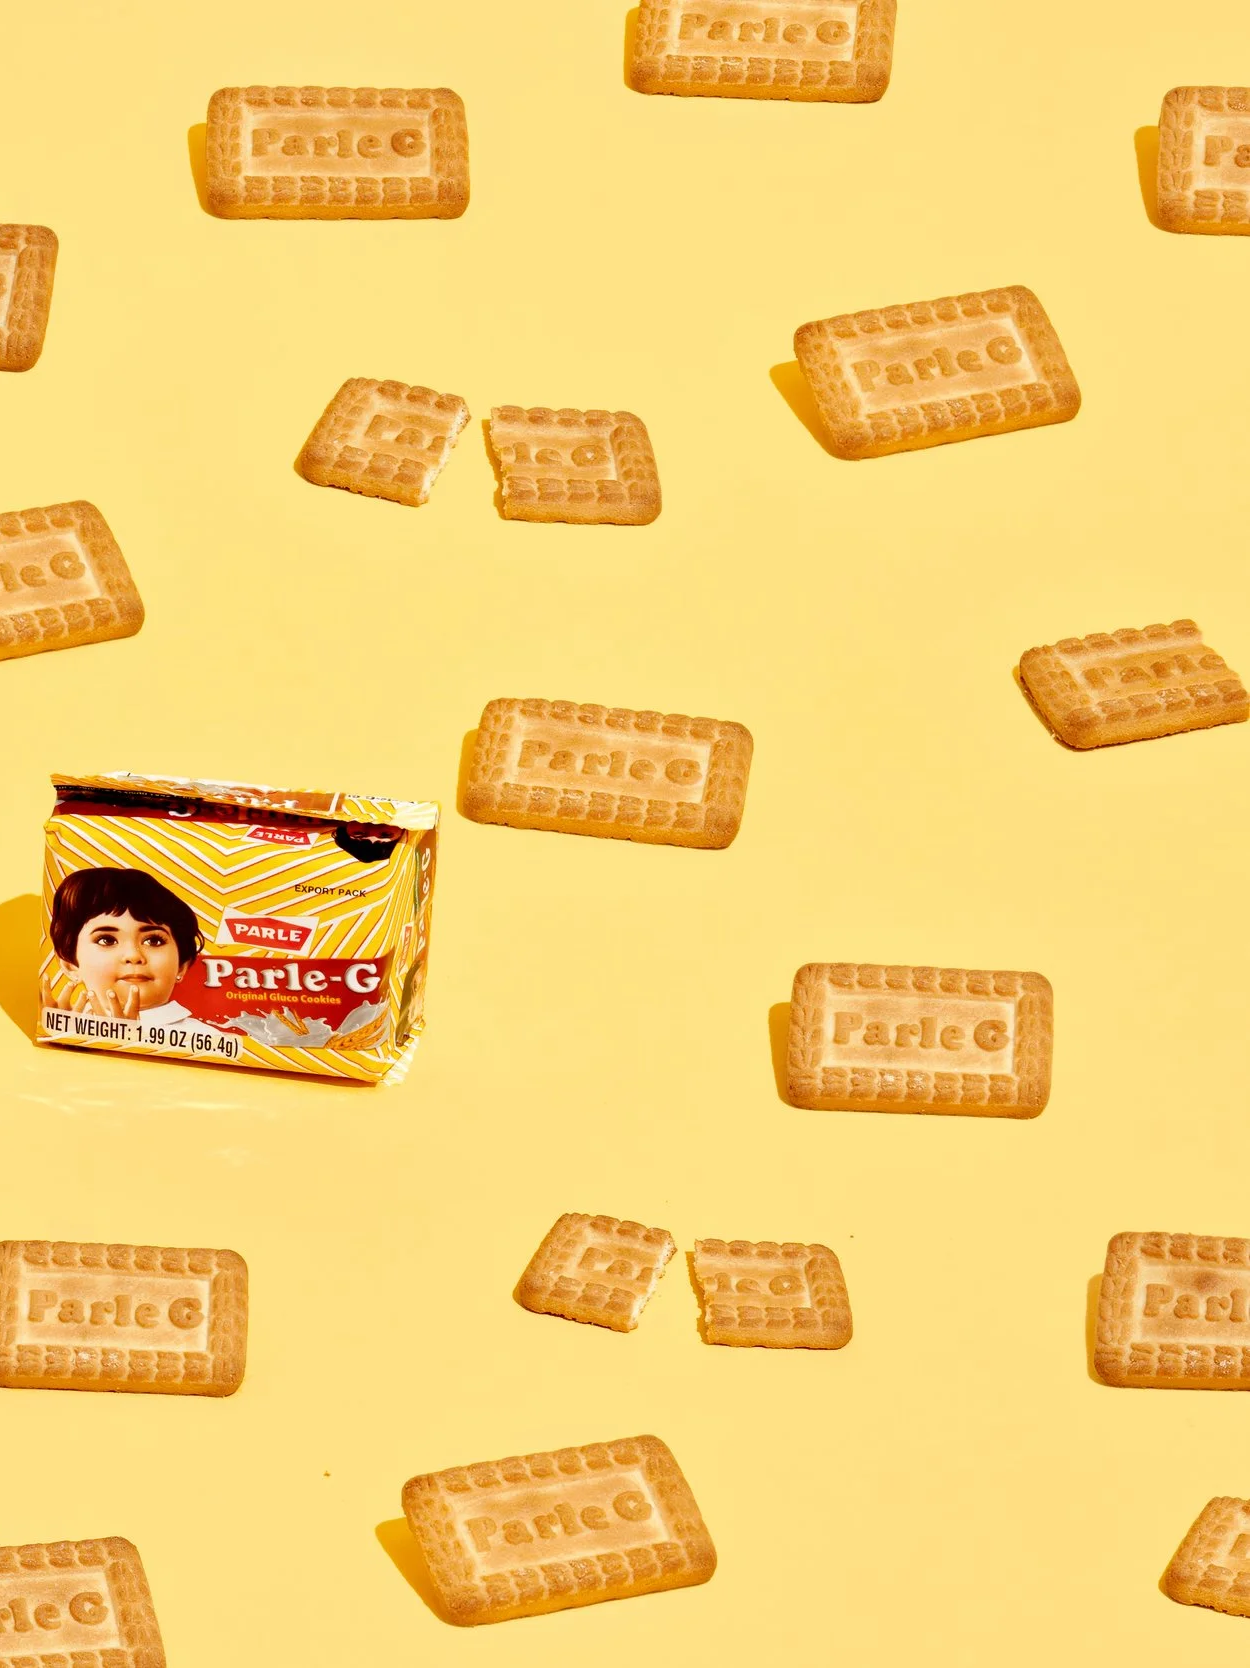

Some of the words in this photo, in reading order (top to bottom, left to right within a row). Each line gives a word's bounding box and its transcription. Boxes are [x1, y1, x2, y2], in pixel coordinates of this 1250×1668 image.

[294, 884, 336, 896] EXPORT
[338, 888, 367, 898] PACK
[234, 923, 302, 943] PARLE
[202, 959, 381, 994] Parle-G
[226, 991, 266, 1003] Original
[269, 993, 298, 1003] Gluco
[300, 994, 341, 1005] Cookies
[46, 1012, 71, 1033] NET
[75, 1017, 132, 1041] WEIGHT:
[137, 1025, 165, 1045] 1.99
[170, 1031, 187, 1046] OZ
[191, 1034, 239, 1057] (56.4g)
